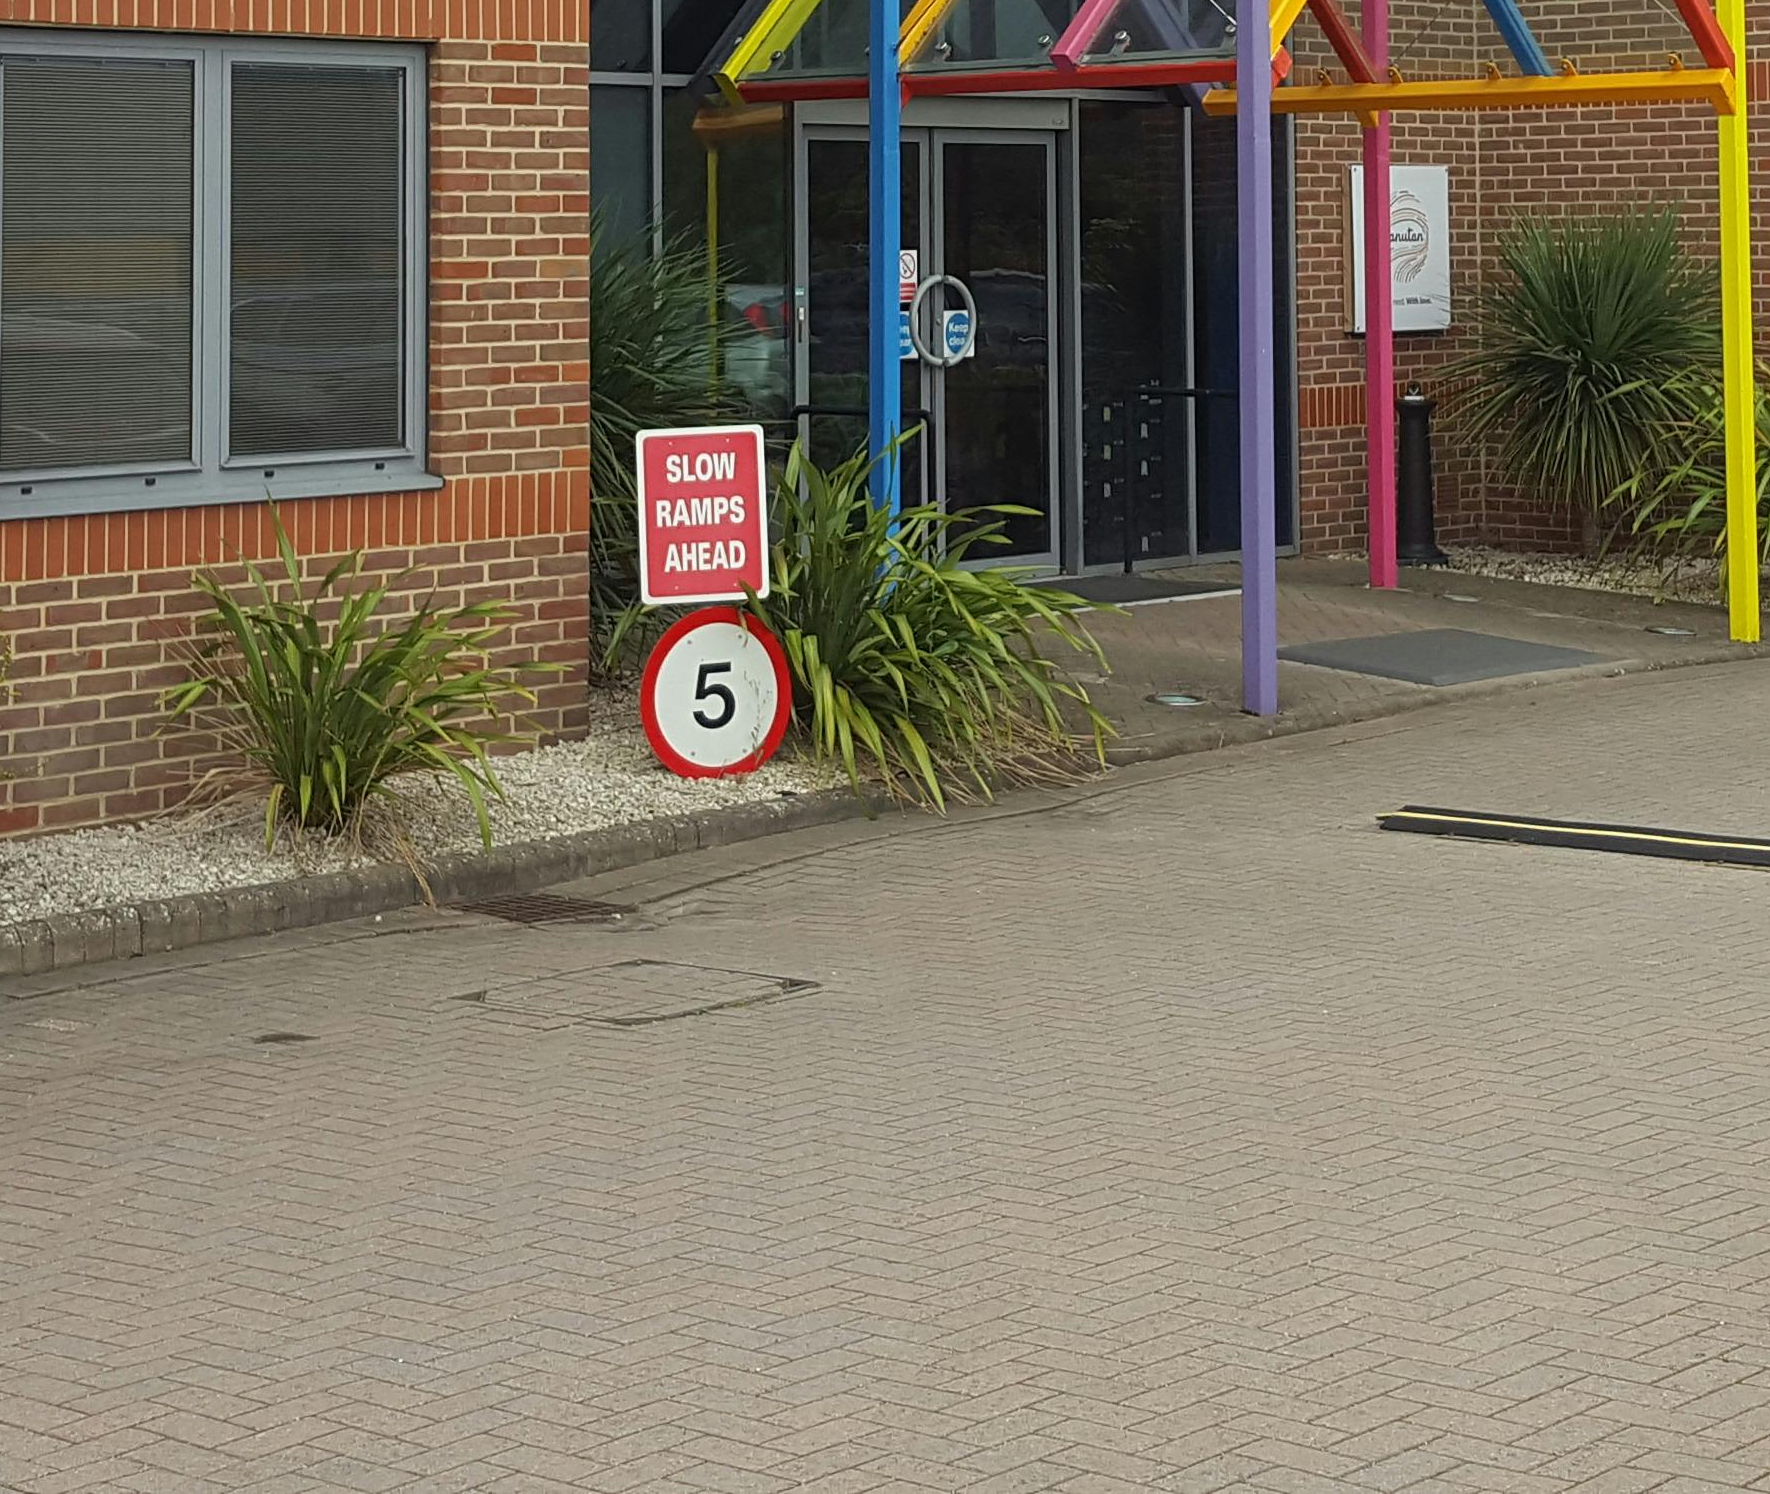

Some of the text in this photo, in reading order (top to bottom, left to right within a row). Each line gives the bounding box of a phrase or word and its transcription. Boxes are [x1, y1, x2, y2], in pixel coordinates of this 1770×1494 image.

[1390, 227, 1424, 242] anutan
[948, 322, 969, 335] Keep
[949, 336, 966, 347] clea
[666, 452, 736, 483] SLOW
[656, 495, 746, 528] RAMPS
[664, 540, 746, 573] AHEAD
[693, 662, 736, 729] 5
